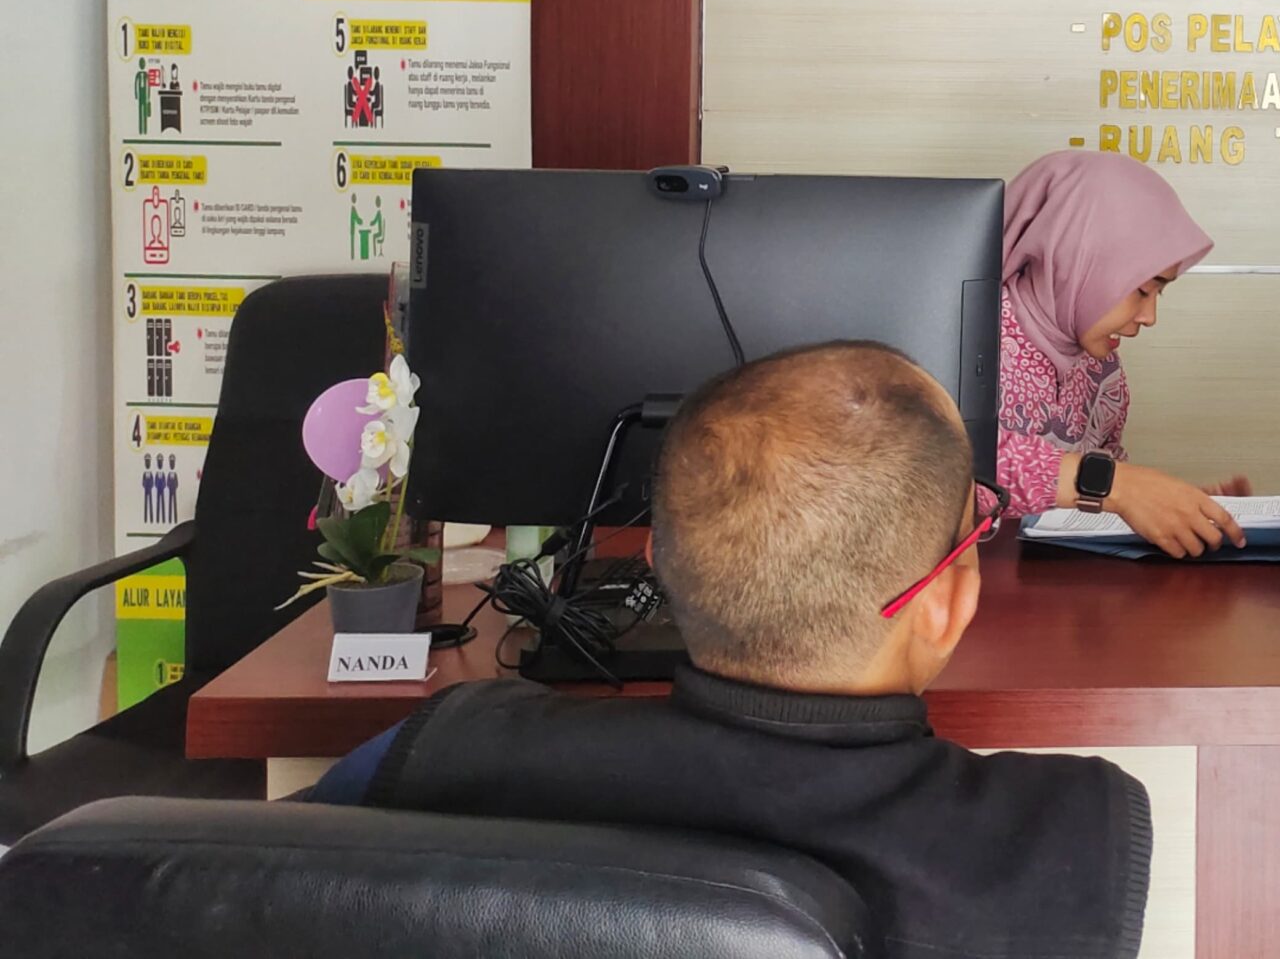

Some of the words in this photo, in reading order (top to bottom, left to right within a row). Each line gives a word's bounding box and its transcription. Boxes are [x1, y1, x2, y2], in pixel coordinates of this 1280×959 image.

[121, 23, 128, 57] 1
[336, 18, 345, 52] 5
[1102, 13, 1173, 52] POS
[1101, 124, 1245, 166] RUANG
[124, 152, 134, 186] 2
[337, 152, 346, 187] 6
[413, 228, 425, 283] Lenovo
[127, 283, 136, 318] 3
[132, 414, 141, 448] 4
[122, 588, 150, 607] ALUR
[158, 661, 163, 685] 1
[336, 654, 409, 673] NANDA
